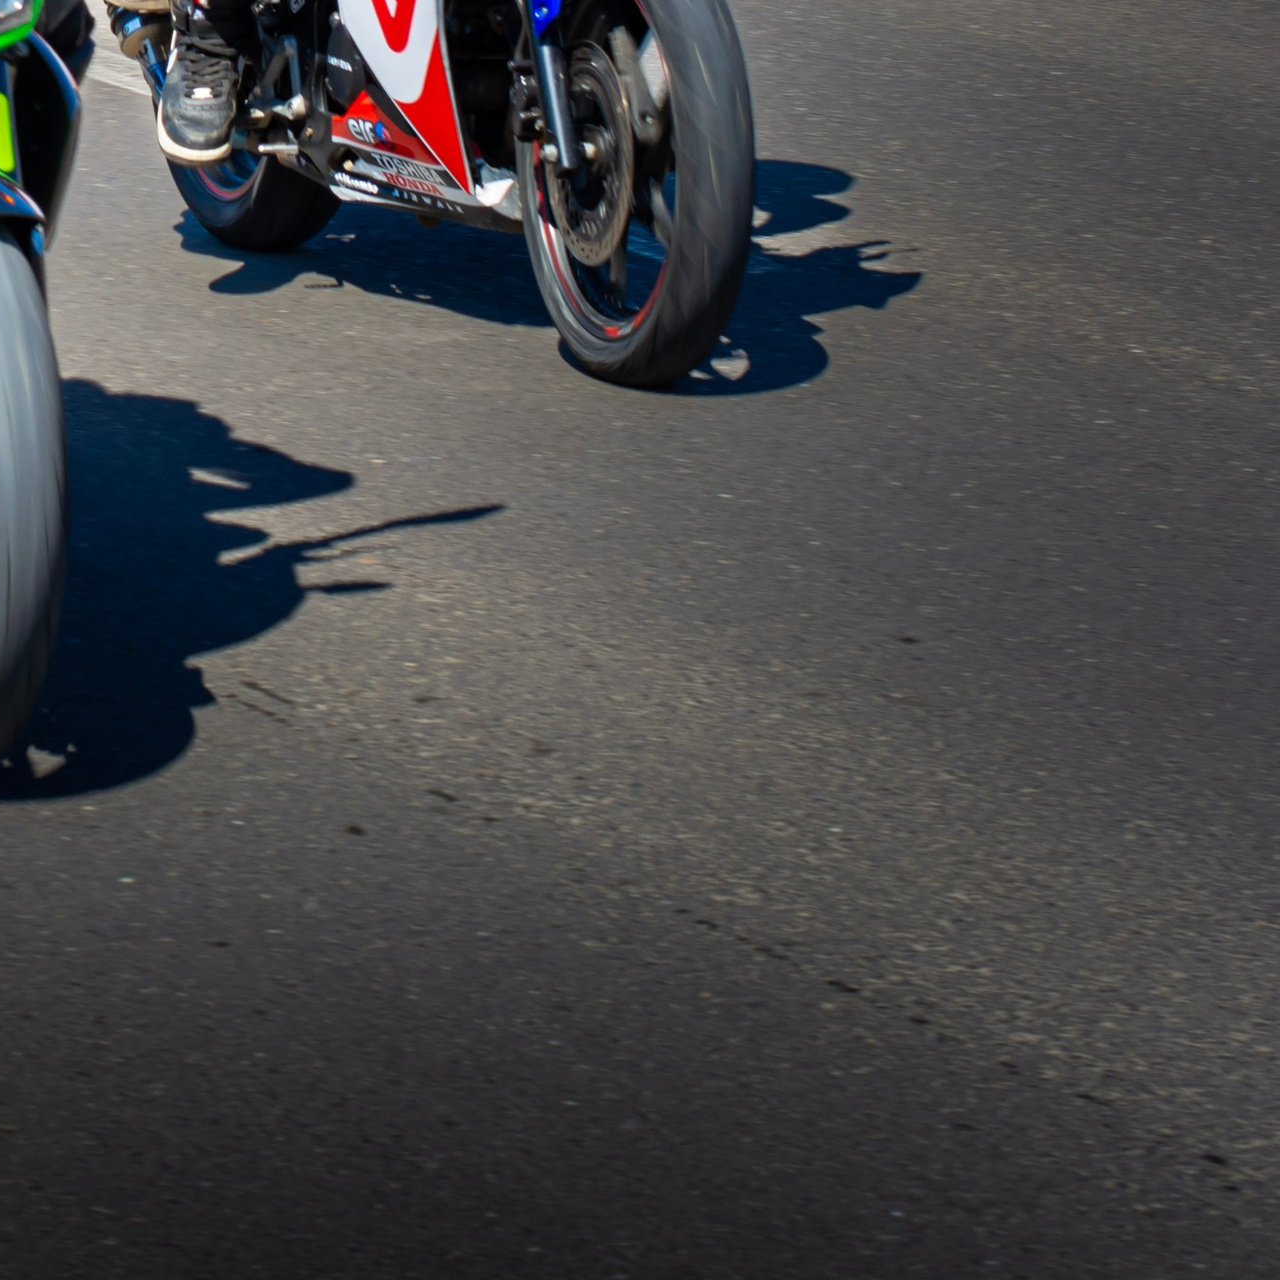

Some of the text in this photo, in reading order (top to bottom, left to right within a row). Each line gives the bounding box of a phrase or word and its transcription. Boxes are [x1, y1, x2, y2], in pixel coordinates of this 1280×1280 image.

[347, 117, 376, 145] elf
[370, 152, 447, 186] TOSHIBA
[381, 170, 445, 197] HONDA
